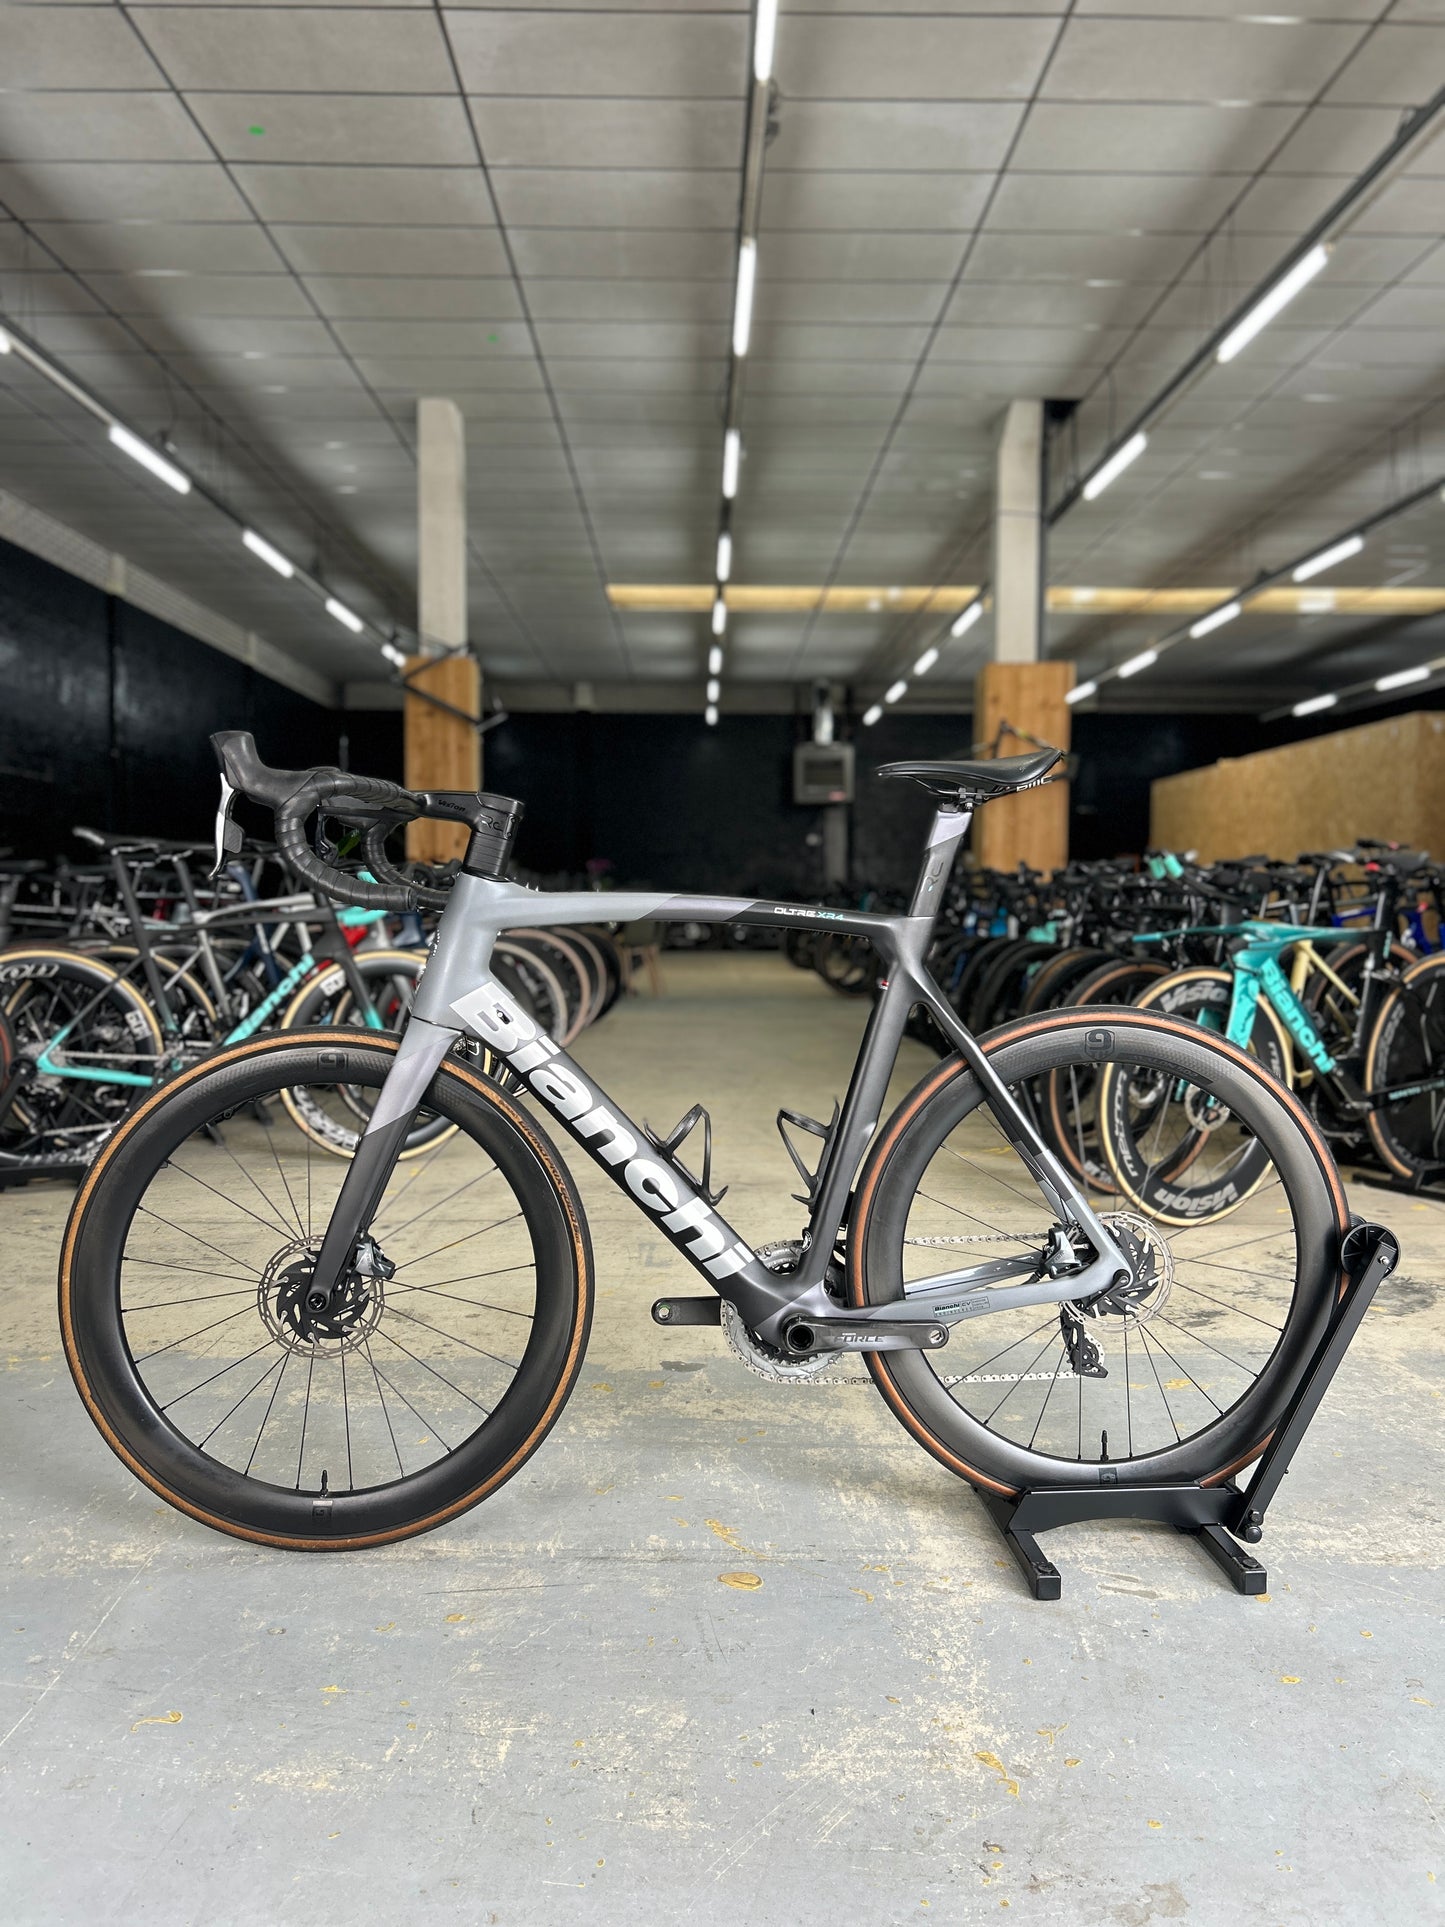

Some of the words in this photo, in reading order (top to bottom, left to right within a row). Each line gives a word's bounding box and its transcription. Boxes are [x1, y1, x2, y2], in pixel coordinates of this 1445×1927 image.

[773, 906, 817, 918] OLTRE
[817, 911, 844, 920] XR4
[1160, 980, 1229, 1012] Visio
[1260, 957, 1336, 1074] Bianchi
[449, 981, 755, 1279] Bianchi
[1114, 1069, 1139, 1178] metron
[1153, 1182, 1239, 1217] Vision
[934, 1303, 960, 1311] Bianchi
[834, 1335, 885, 1343] FORCE
